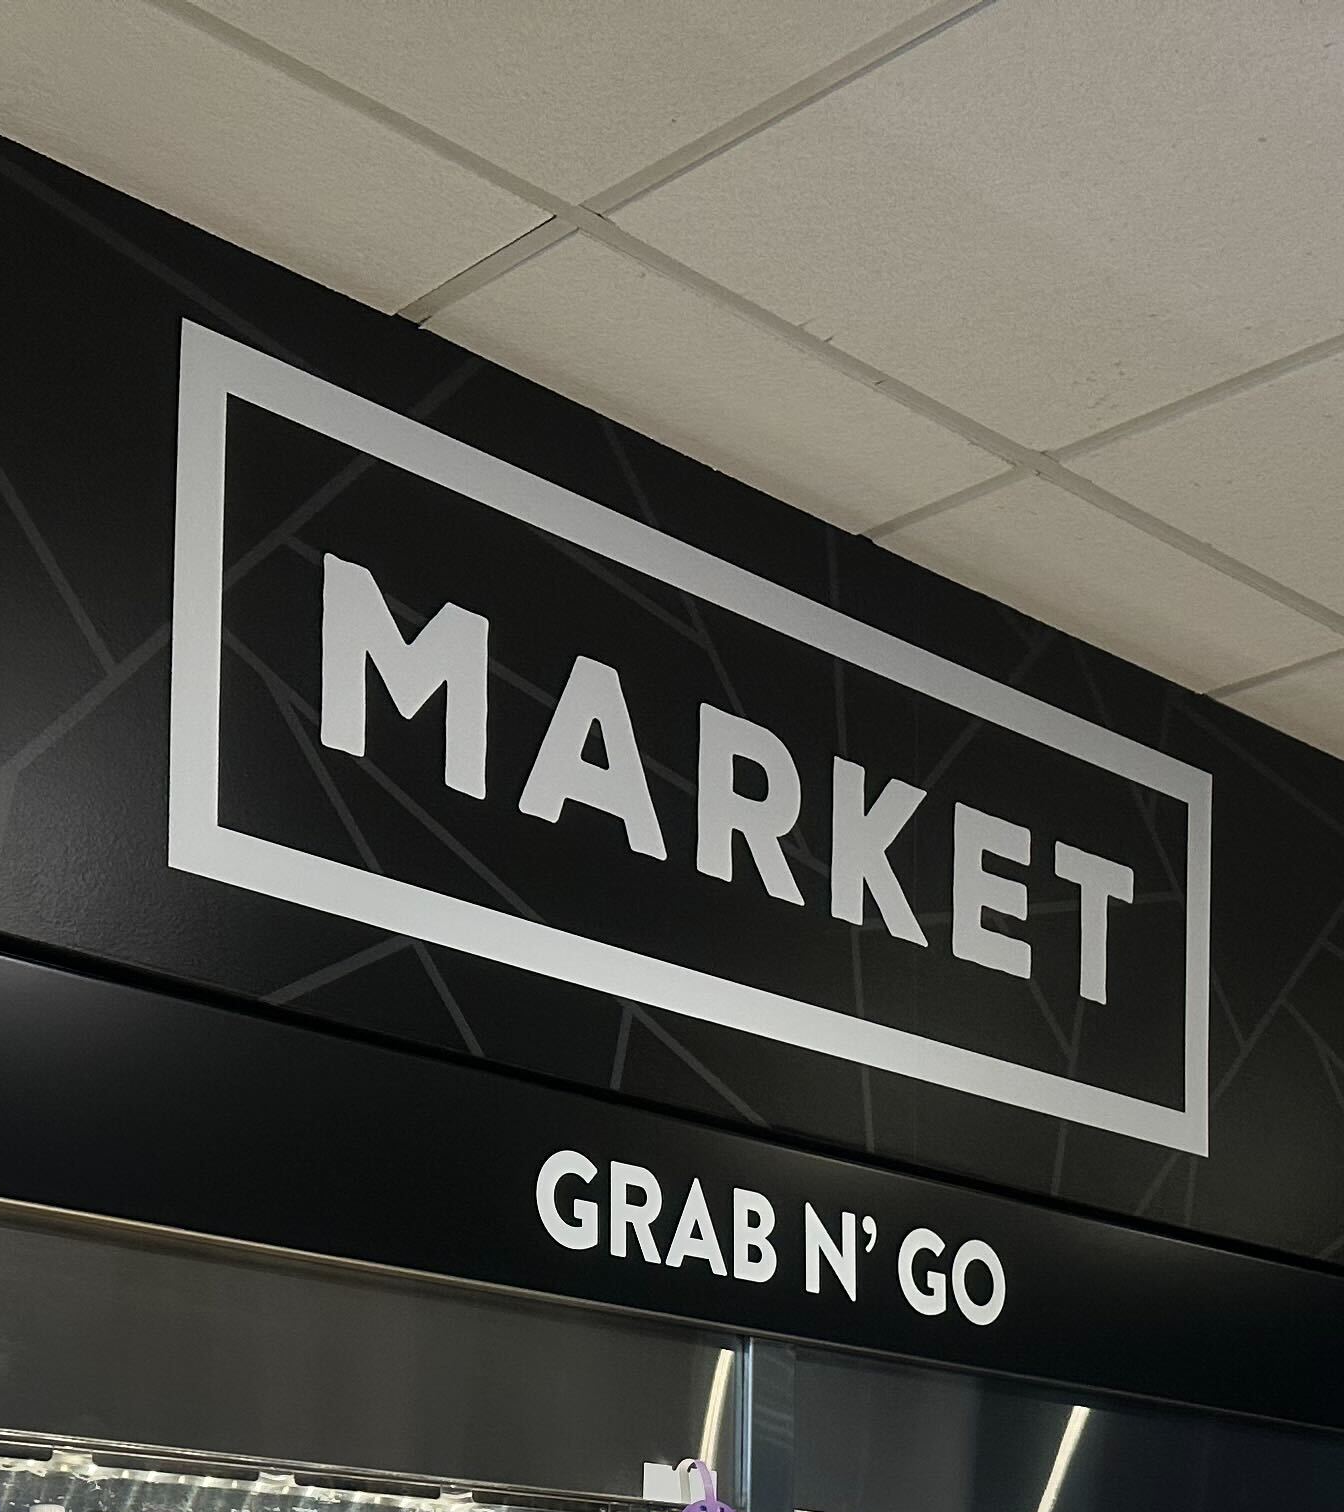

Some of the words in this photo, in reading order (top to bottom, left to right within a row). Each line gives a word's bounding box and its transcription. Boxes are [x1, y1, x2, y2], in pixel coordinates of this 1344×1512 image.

[321, 552, 1134, 1005] MARKET
[537, 1151, 778, 1283] GRAB
[898, 1240, 1006, 1326] GO
